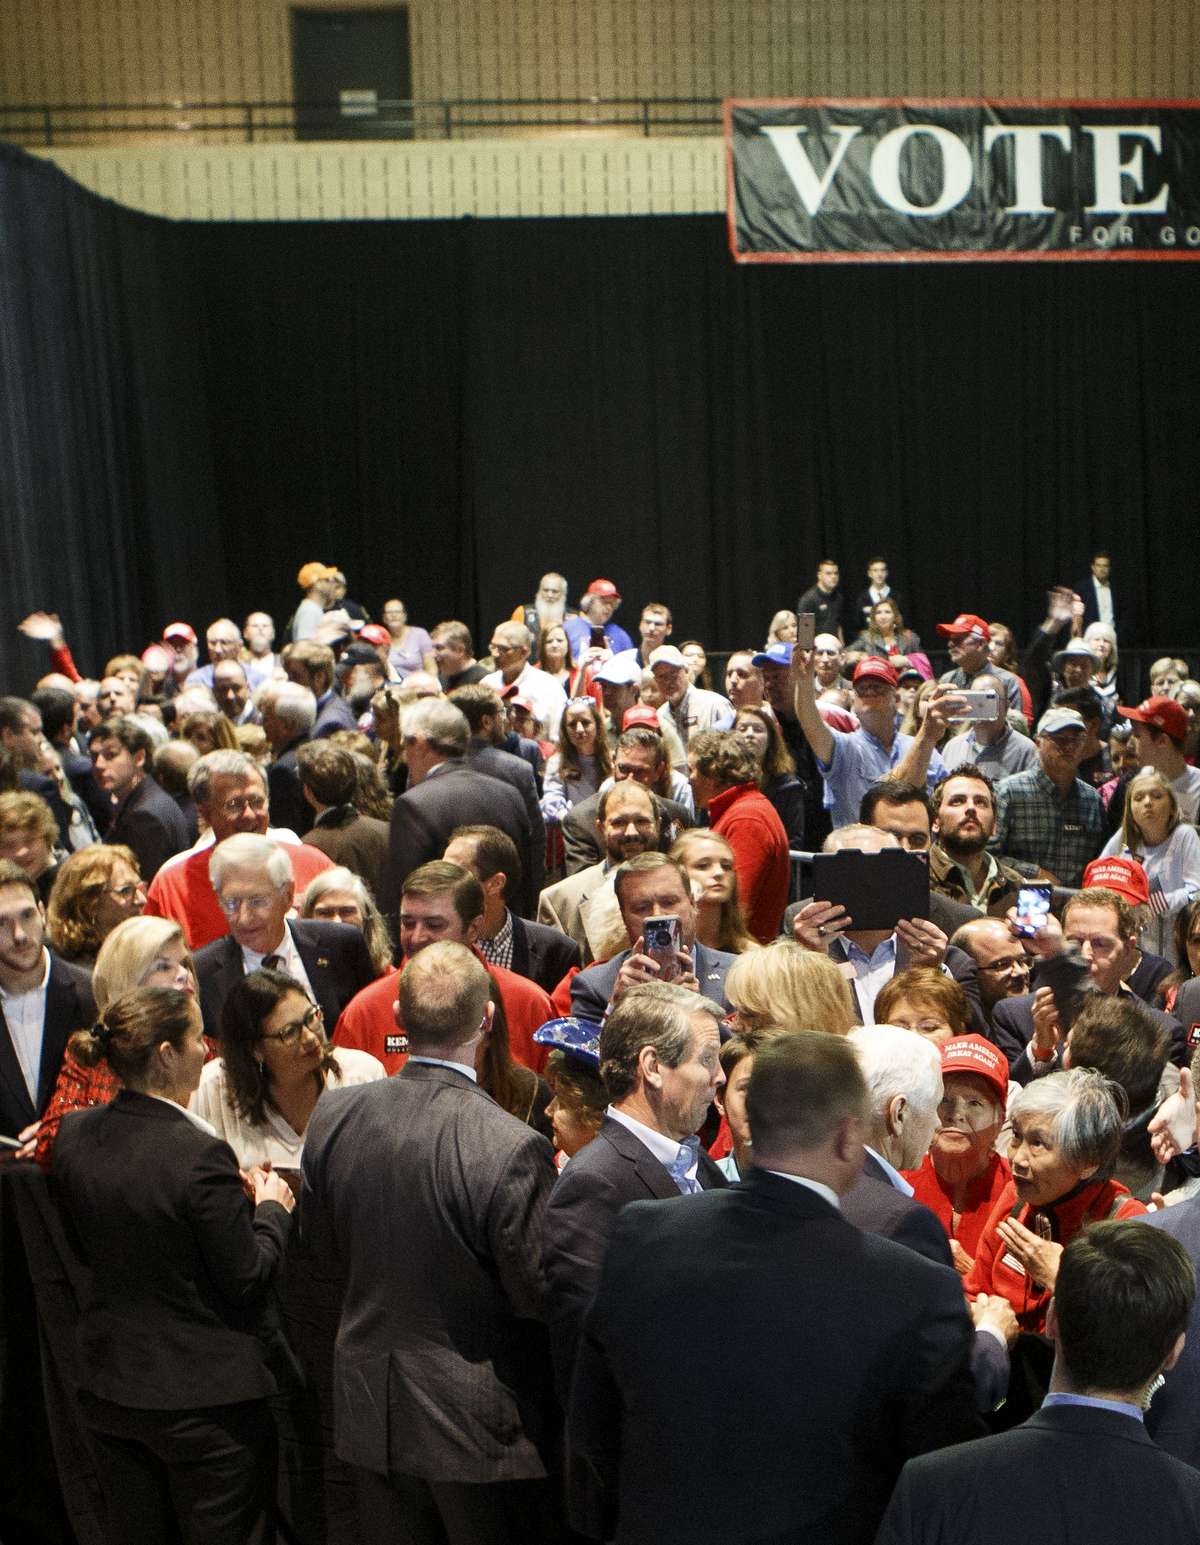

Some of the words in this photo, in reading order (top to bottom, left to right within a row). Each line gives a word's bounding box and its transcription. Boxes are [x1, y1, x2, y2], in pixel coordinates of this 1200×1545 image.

[761, 124, 1169, 217] VOTE
[1069, 225, 1134, 245] FOR
[944, 1041, 968, 1053] MAKE
[968, 1042, 999, 1064] AMERICA
[946, 1050, 973, 1059] GREAT
[972, 1053, 996, 1069] AGAIN
